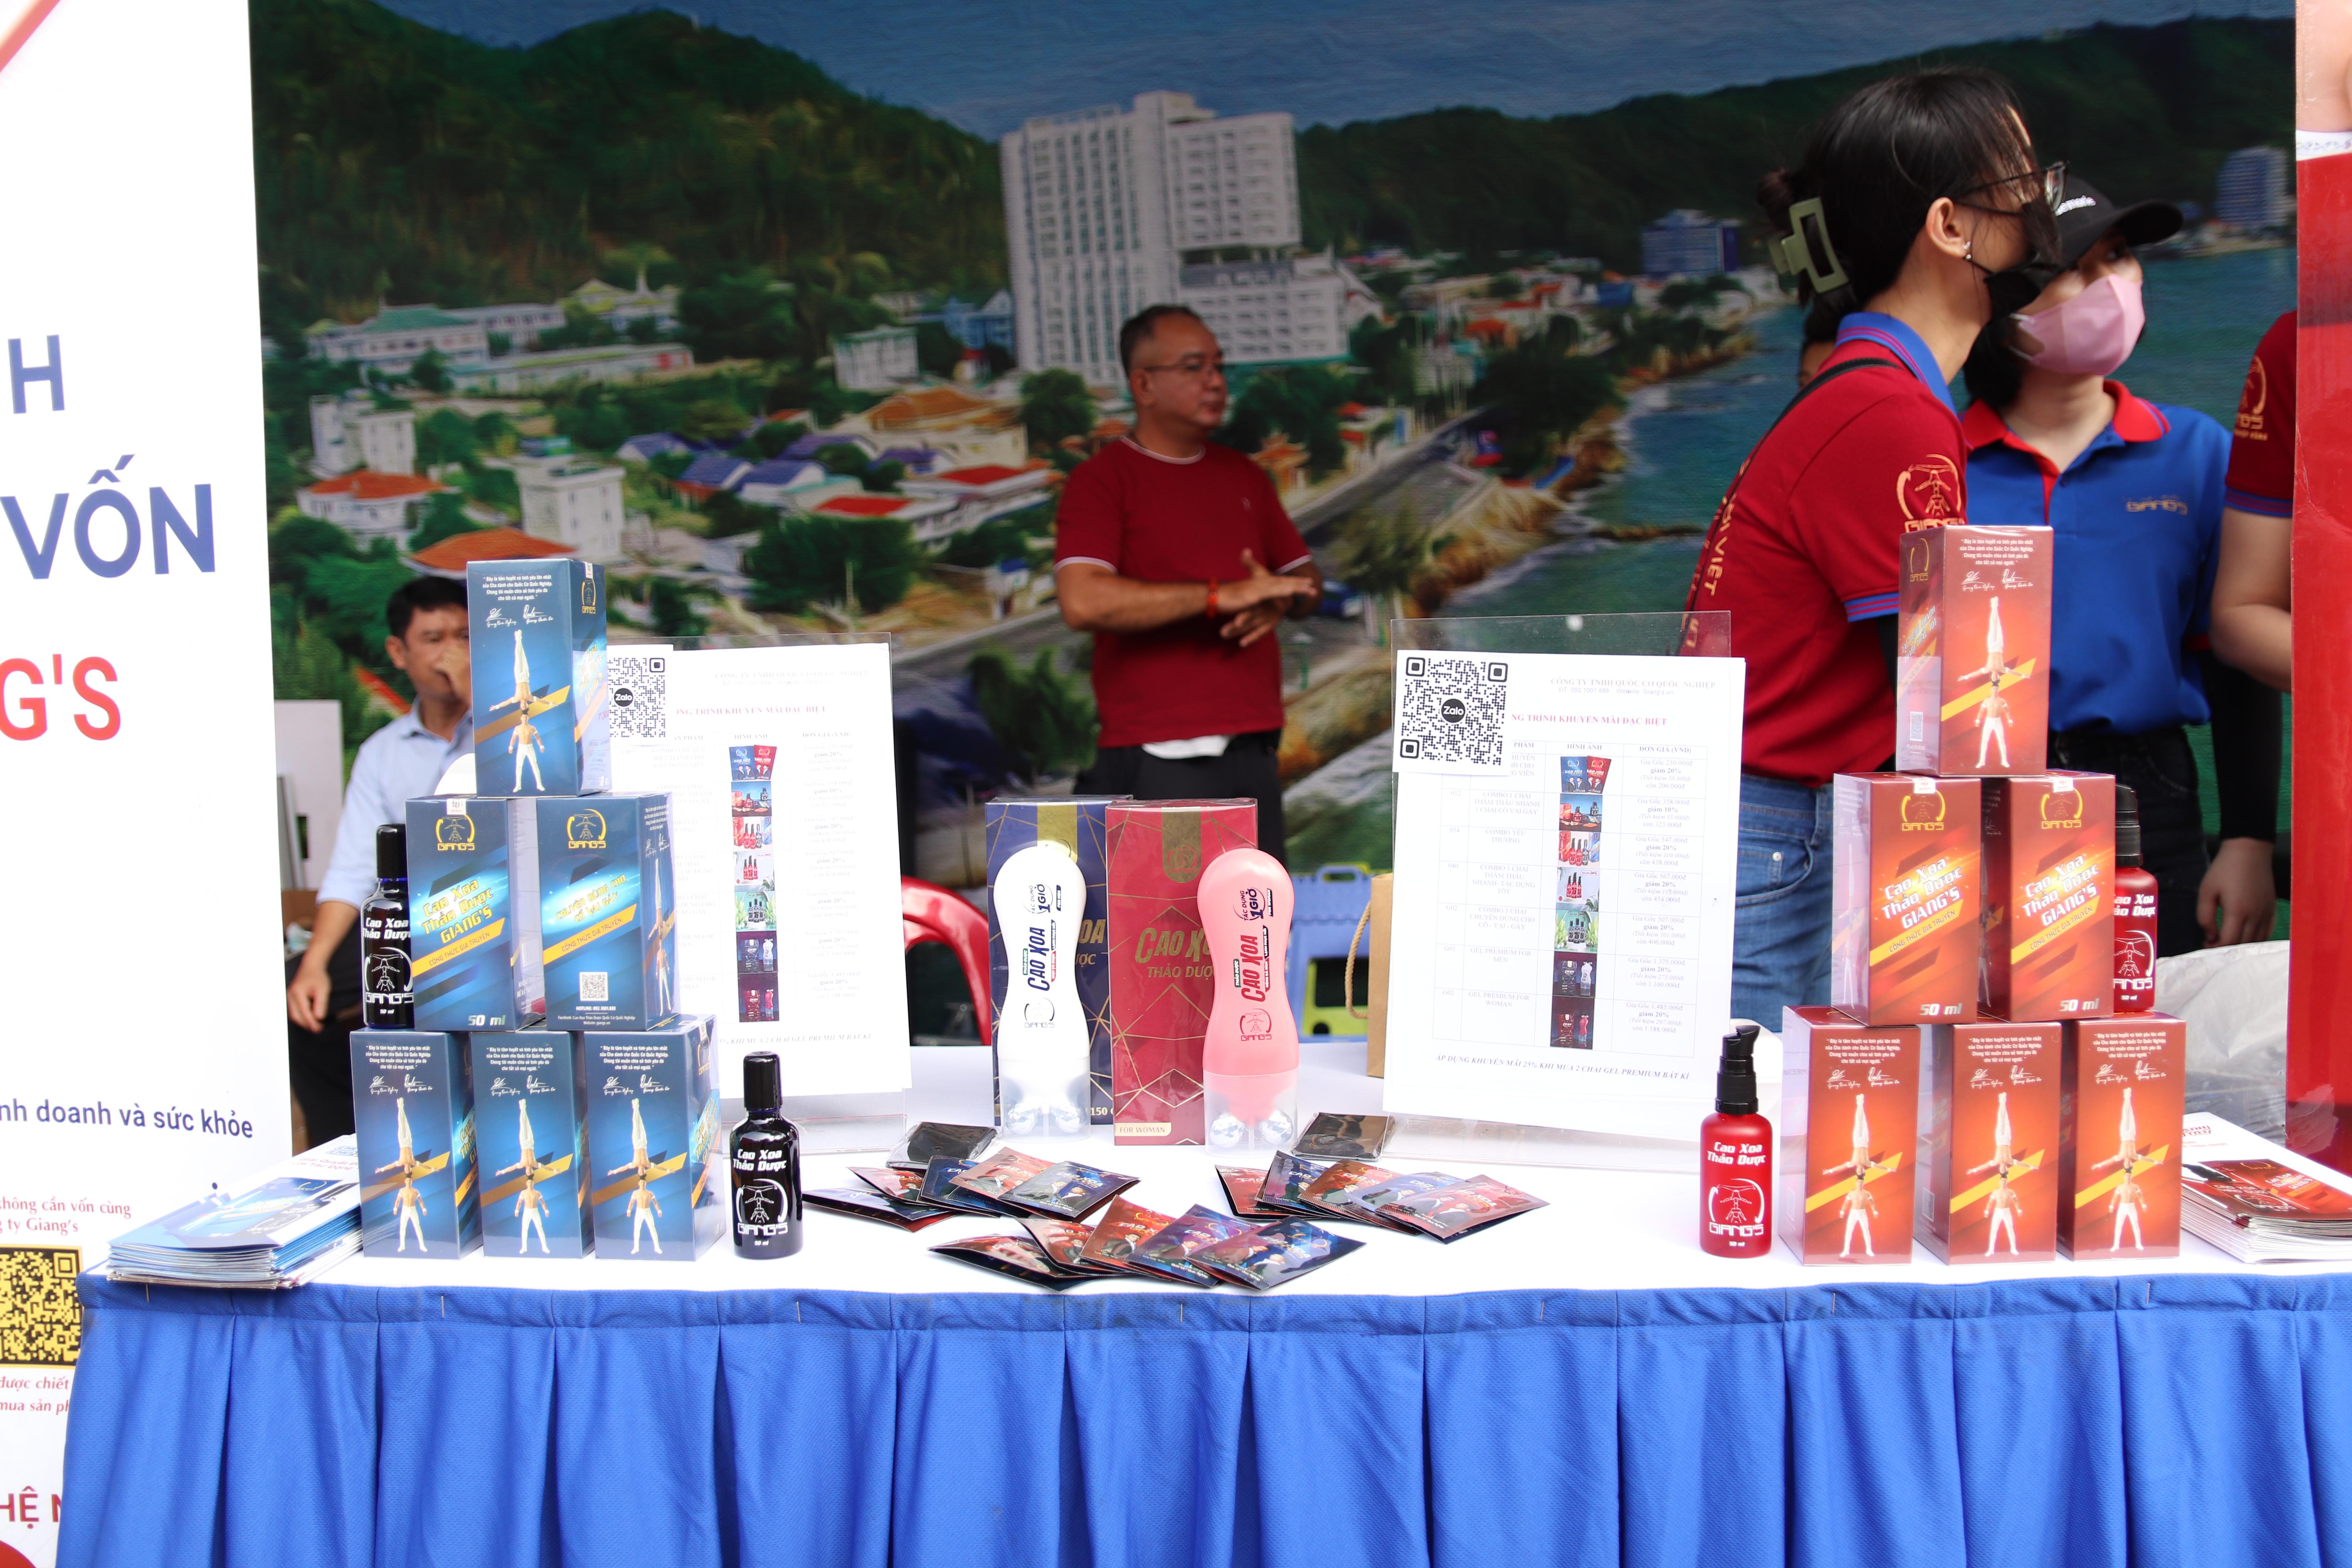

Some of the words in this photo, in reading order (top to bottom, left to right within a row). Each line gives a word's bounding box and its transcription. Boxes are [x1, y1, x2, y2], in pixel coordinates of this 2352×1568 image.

[8, 334, 65, 414] H
[0, 454, 215, 579] VỐN
[1551, 677, 1574, 686] CÔNG
[1615, 679, 1640, 688] QUỐC
[1656, 680, 1681, 689] QUỐC
[1683, 681, 1716, 690] NGHIỆP
[615, 693, 632, 702] Zalo
[1443, 706, 1464, 715] Zalo
[1527, 713, 1556, 722] TRÌNH
[1559, 715, 1599, 724] KHUYẾN
[1601, 715, 1619, 724] MÃI
[1622, 717, 1642, 726] ĐẶC
[1645, 718, 1667, 727] BIỆT
[1902, 822, 1944, 831] GIANG'S
[2042, 820, 2082, 829] GIANG'S
[568, 840, 606, 849] GIANG'S
[1884, 877, 1912, 900] Cao
[1916, 858, 1946, 882] Xoa
[2025, 876, 2051, 898] Cao
[2054, 855, 2084, 880] Xoa
[423, 897, 449, 917] Cao
[451, 879, 479, 902] Xoa
[556, 897, 586, 920] CHUYÊN
[587, 884, 610, 902] DÙNG
[610, 874, 626, 888] CHO
[1882, 892, 1920, 919] Thảo
[1923, 867, 1963, 897] Dược
[2023, 890, 2058, 917] Thảo
[2062, 864, 2099, 894] Dược
[2134, 894, 2154, 904] Xoa
[421, 910, 456, 935] Thảo
[459, 887, 494, 914] Dược
[575, 908, 585, 922] CỔ
[586, 902, 601, 916] VAI
[602, 891, 619, 906] GÁY
[1902, 885, 1960, 929] GIANG'S
[2042, 882, 2097, 926] GIANG'S
[2132, 906, 2156, 917] Dược
[366, 917, 381, 928] Cao
[385, 918, 409, 928] Xoa
[440, 904, 492, 944] GIANG'S
[1889, 940, 1905, 953] CÔNG
[1906, 929, 1922, 942] THỨC
[1923, 924, 1932, 933] GIA
[1933, 909, 1956, 927] TRUYỀN
[2030, 938, 2045, 950] CÔNG
[2045, 927, 2060, 940] THỨC
[2061, 920, 2071, 930] GIA
[2071, 905, 2093, 924] TRUYỀN
[362, 927, 381, 939] Thảo
[562, 940, 576, 952] CÔNG
[577, 933, 591, 944] THỨC
[602, 917, 622, 931] TRUYỀN
[1029, 927, 1049, 956] XOA
[429, 954, 444, 966] CÔNG
[444, 946, 459, 958] THỨC
[469, 931, 490, 946] TRUYỀN
[1135, 927, 1185, 964] CAO
[1240, 935, 1263, 965] XOA
[1027, 960, 1050, 991] CAO
[1147, 963, 1181, 978] THẢO
[1241, 969, 1265, 1002] CAO
[365, 992, 414, 1004] GIANG'S
[2059, 1000, 2078, 1012] 50
[2082, 998, 2099, 1010] ml
[1920, 1004, 1939, 1015] 50
[1944, 1003, 1962, 1015] ml
[468, 1014, 485, 1025] 50
[490, 1014, 506, 1025] ml
[1447, 1055, 1470, 1063] DỤNG
[1471, 1057, 1505, 1065] KHUYẾN
[1506, 1058, 1522, 1067] MÃI
[1621, 1069, 1661, 1078] PREMIUM
[1662, 1070, 1680, 1079] BẤT
[36, 1099, 111, 1125] doanh
[119, 1103, 145, 1127] và
[154, 1106, 194, 1131] sức
[201, 1109, 253, 1138] khỏe
[1091, 1107, 1107, 1116] 150
[737, 1149, 755, 1160] Cao
[759, 1149, 782, 1160] Xoa
[1714, 1142, 1735, 1153] Cao
[1739, 1143, 1762, 1153] Xoa
[733, 1158, 754, 1171] Thảo
[757, 1160, 787, 1172] Dược
[1707, 1151, 1734, 1164] Thảo
[1737, 1155, 1766, 1166] Dược
[42, 1196, 65, 1211] cần
[71, 1197, 94, 1212] vốn
[100, 1200, 131, 1219] cùng
[7, 1218, 20, 1234] ty
[26, 1217, 78, 1236] Giang's
[737, 1222, 788, 1236] GIANG'S
[1709, 1221, 1764, 1236] GIANG'S
[36, 1376, 69, 1390] chiết
[29, 1399, 51, 1412] sản
